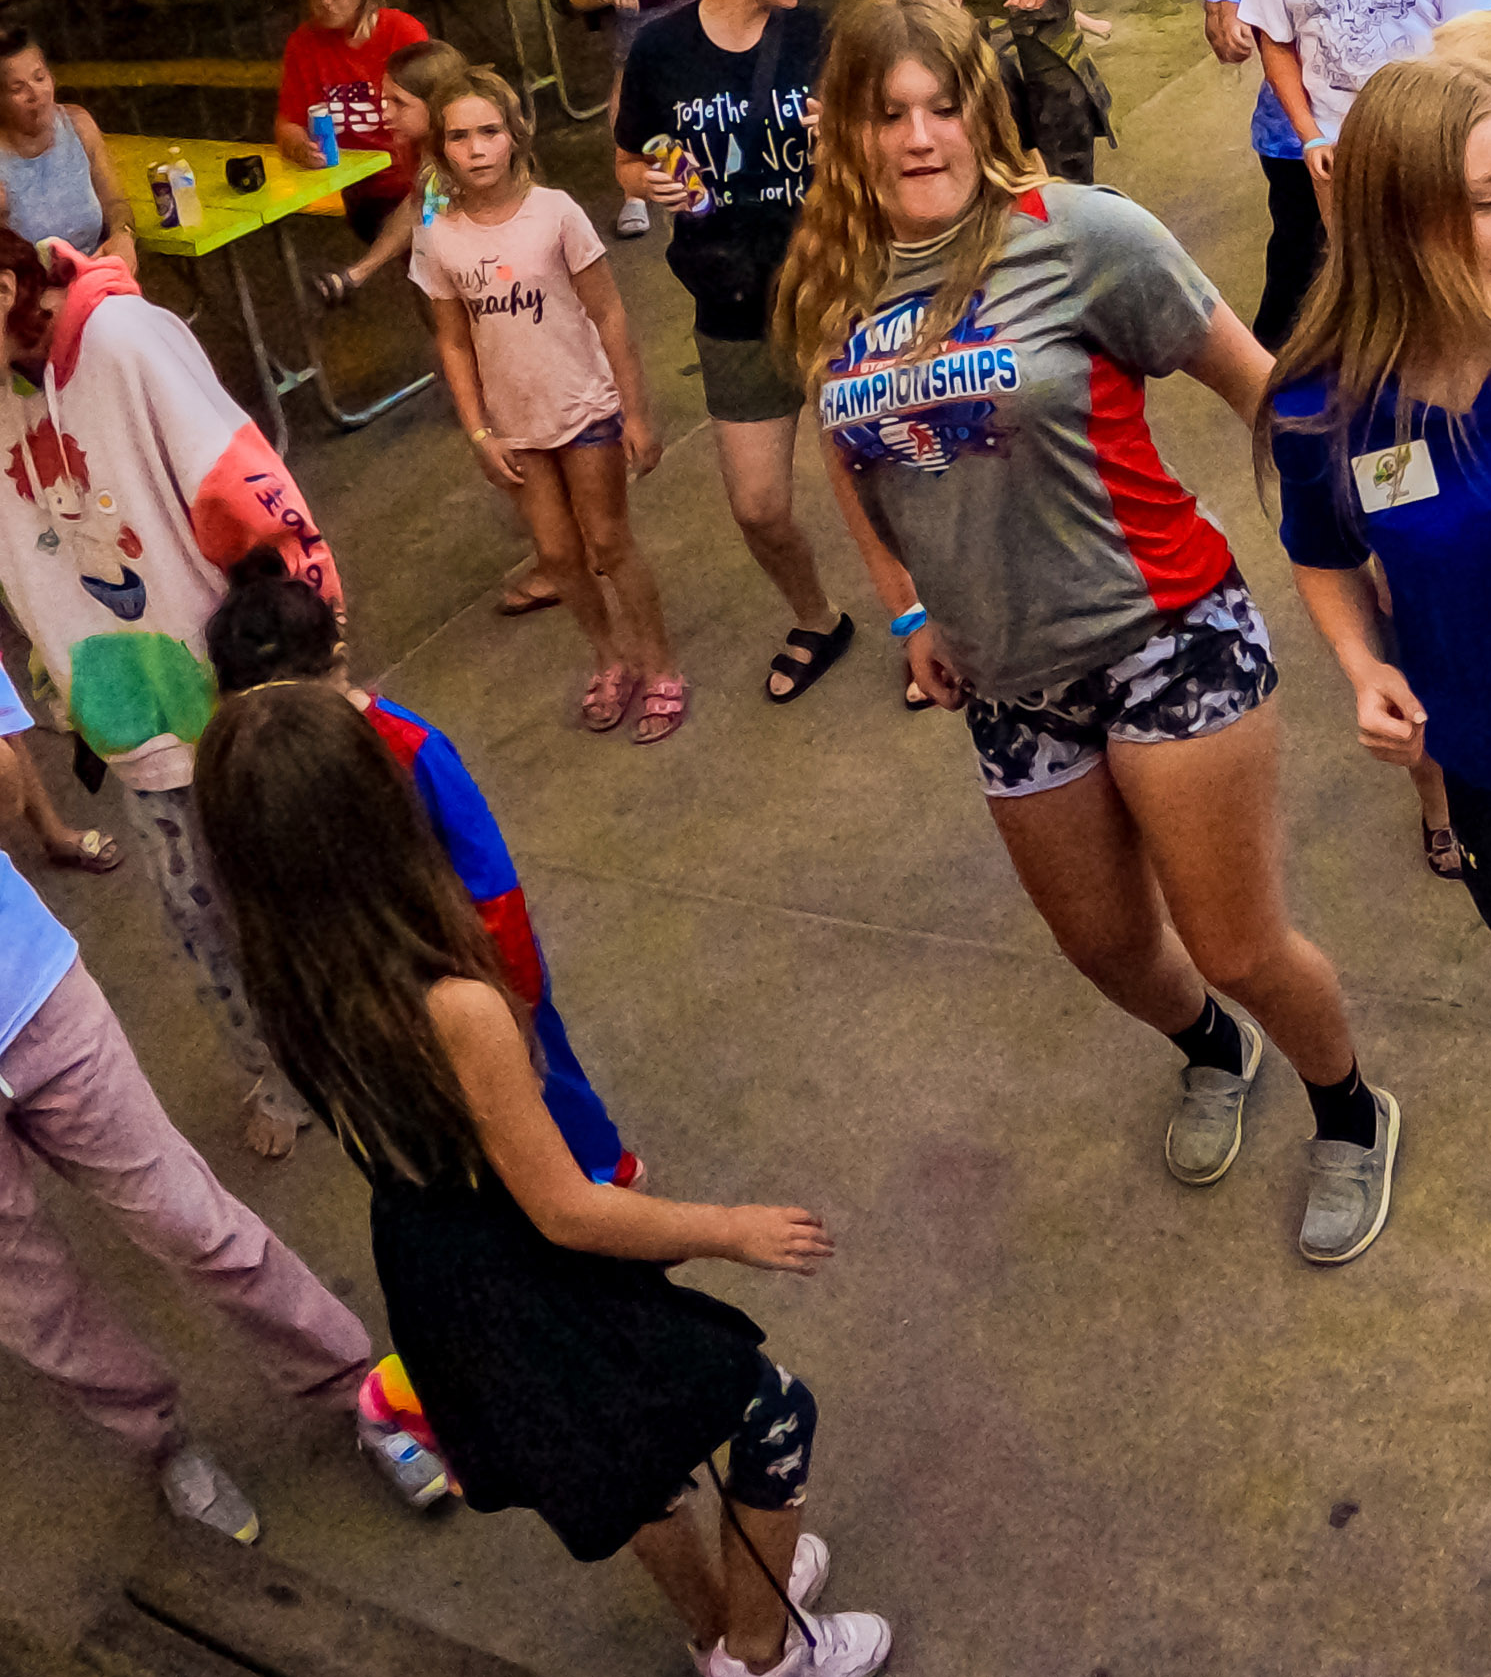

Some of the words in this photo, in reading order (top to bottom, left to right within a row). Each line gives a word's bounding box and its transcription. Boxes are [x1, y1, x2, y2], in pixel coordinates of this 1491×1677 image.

[672, 91, 750, 132] togethe
[771, 85, 809, 131] let'
[760, 176, 806, 207] orld
[820, 344, 1020, 429] HAMPIONSHIPS
